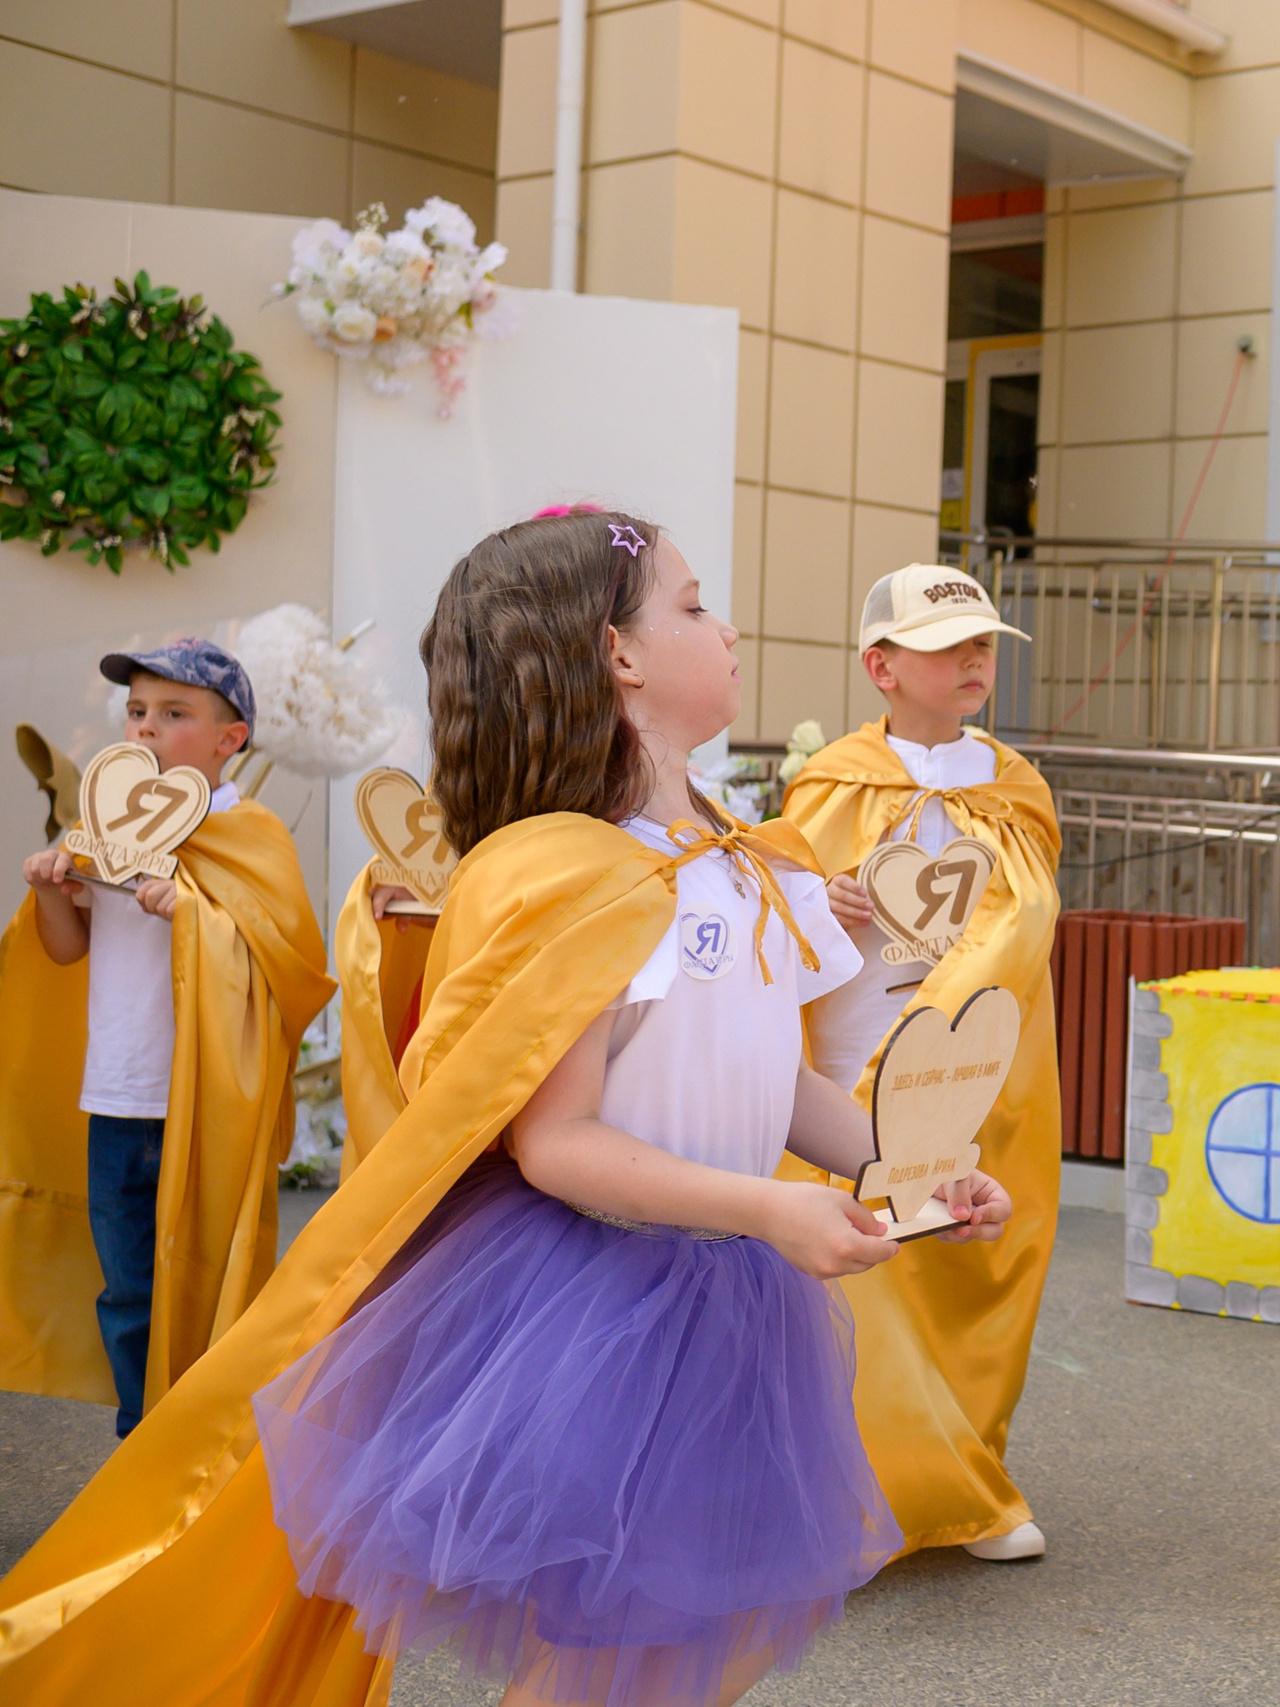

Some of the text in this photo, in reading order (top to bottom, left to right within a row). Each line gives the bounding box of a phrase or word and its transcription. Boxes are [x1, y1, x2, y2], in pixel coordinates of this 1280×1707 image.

[923, 582, 982, 604] BOSTON
[106, 778, 189, 843] Я
[68, 833, 174, 875] ФАНТАЗЁРЫ
[913, 859, 978, 932] Я
[695, 921, 722, 955] Я
[892, 1074, 914, 1091] ЗДЕСЬ
[914, 1072, 922, 1088] И
[976, 1063, 984, 1079] В
[983, 1060, 1001, 1077] МИРЕ
